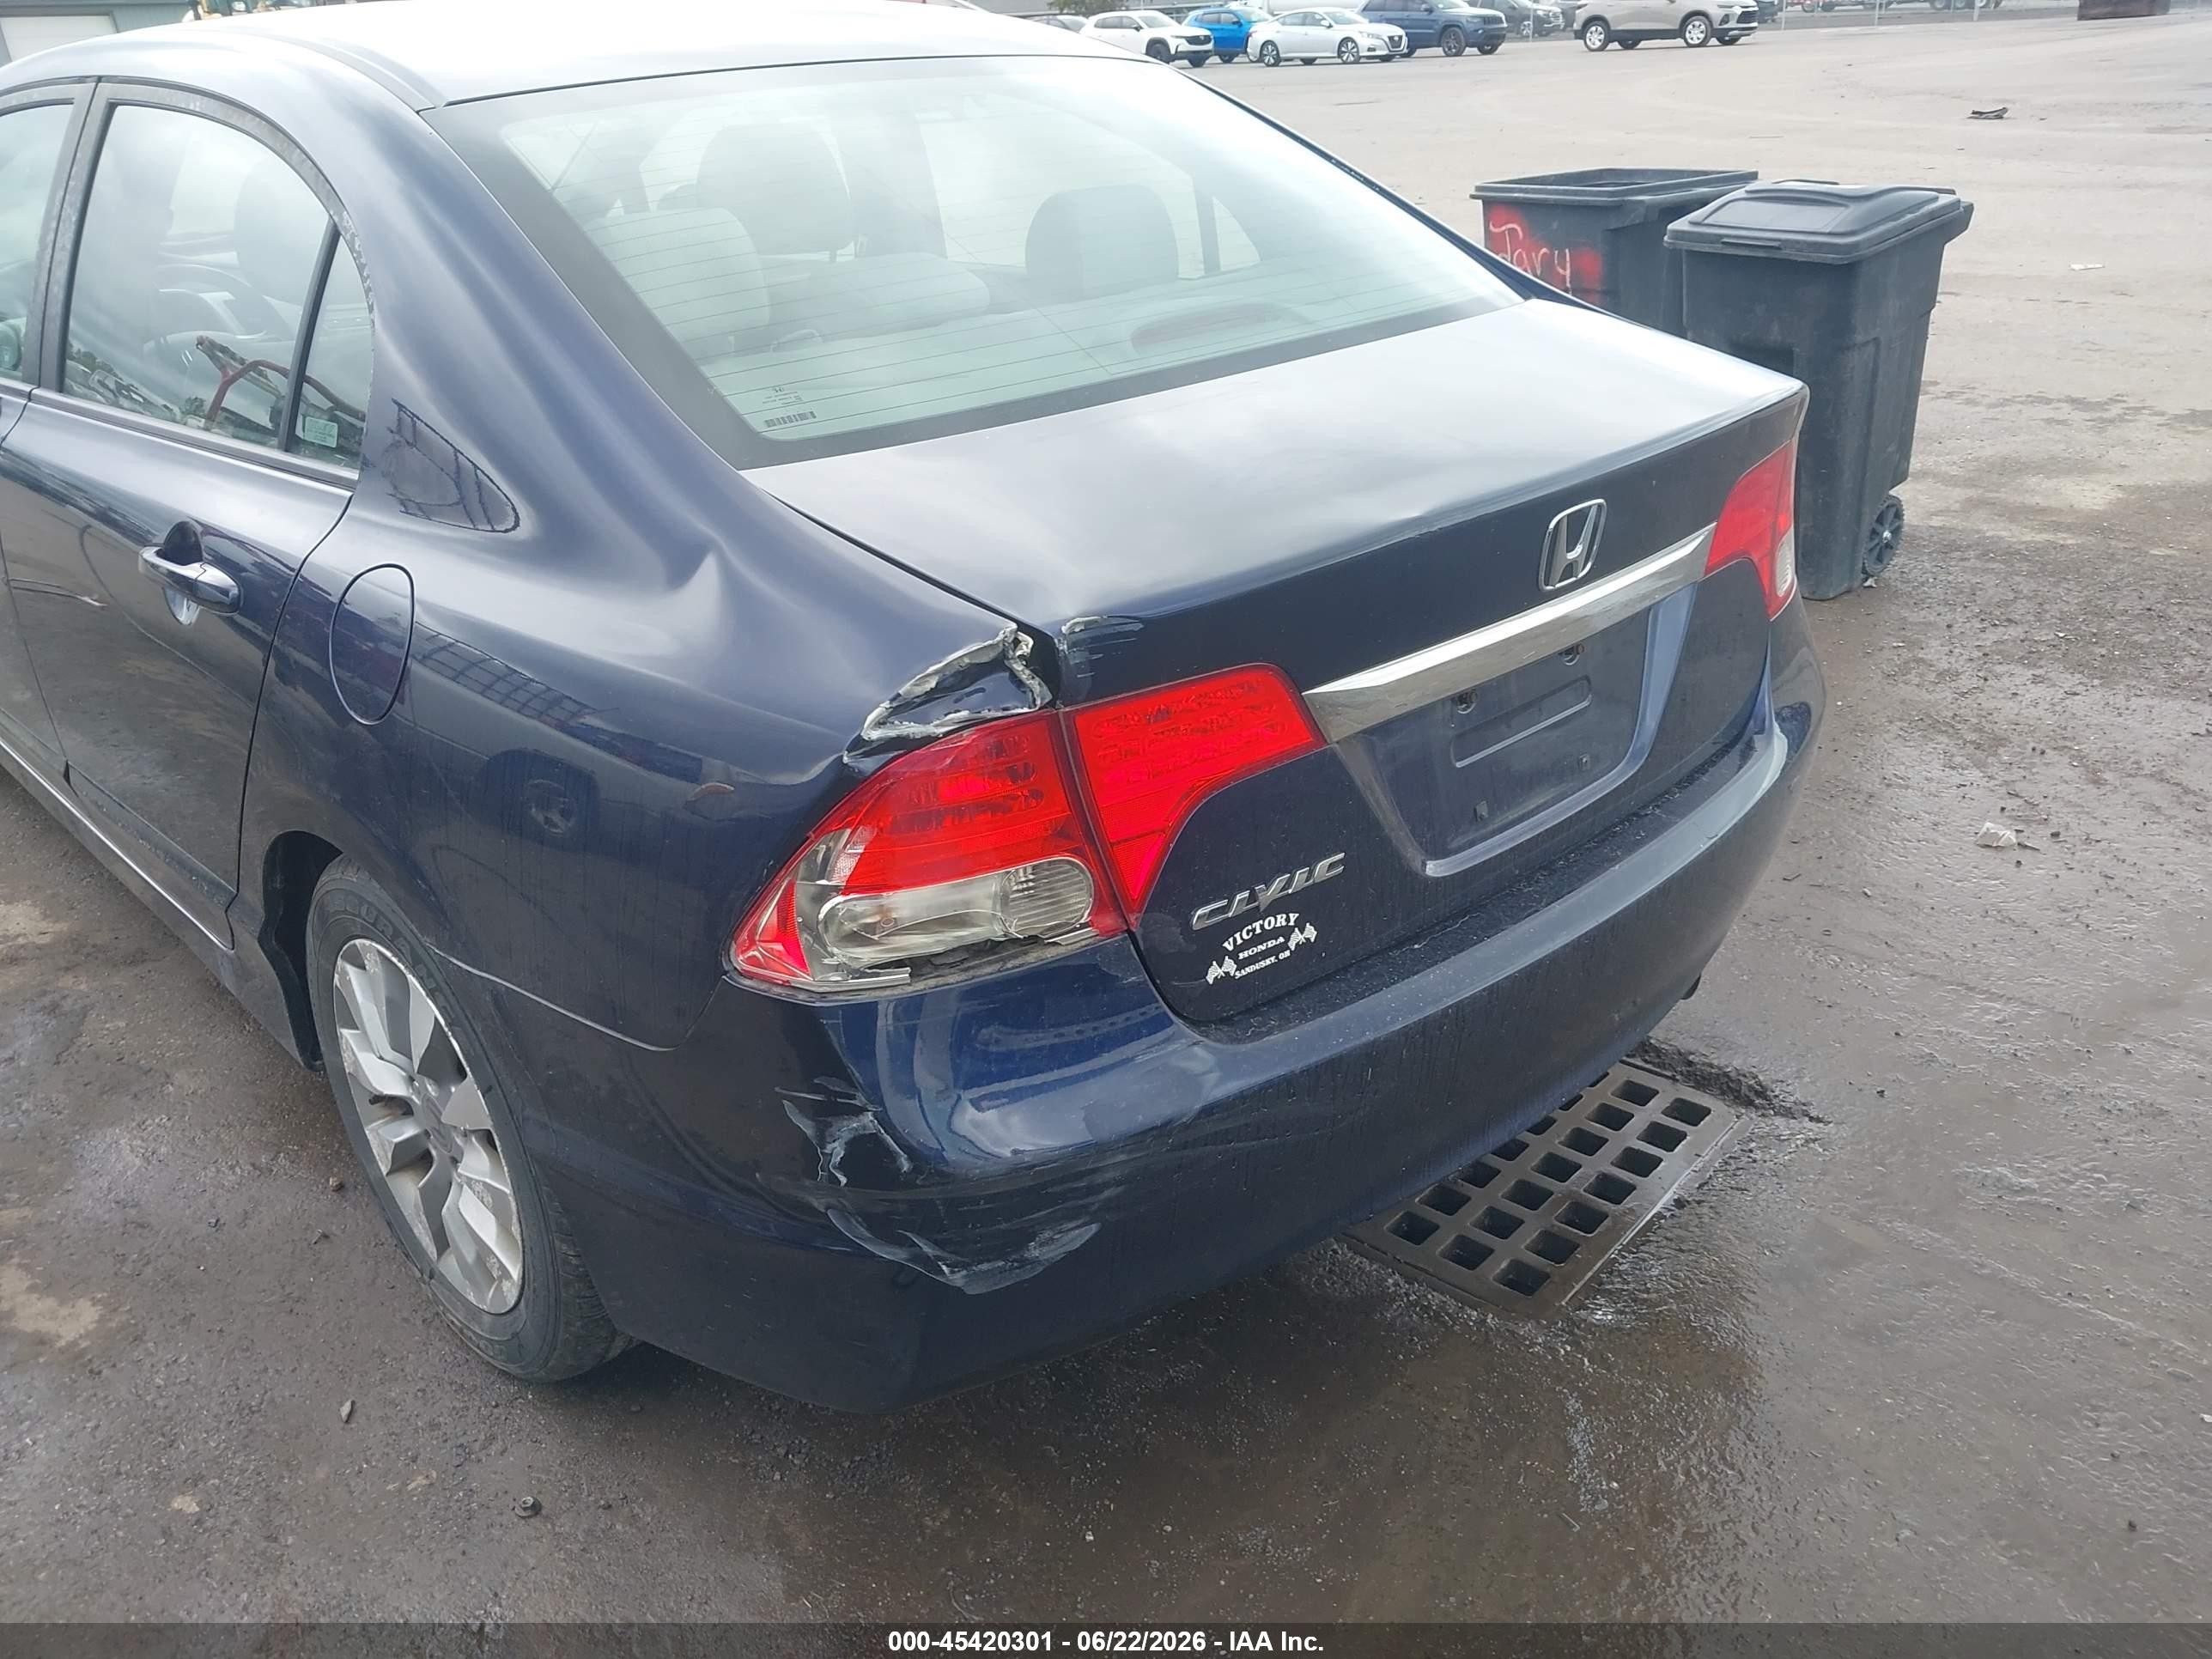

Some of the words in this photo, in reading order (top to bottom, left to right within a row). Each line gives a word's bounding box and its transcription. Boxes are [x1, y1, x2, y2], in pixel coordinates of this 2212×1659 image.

[1190, 852, 1346, 931] CIVIC
[1222, 913, 1300, 951] VICTORY
[1237, 936, 1285, 960] HONDA
